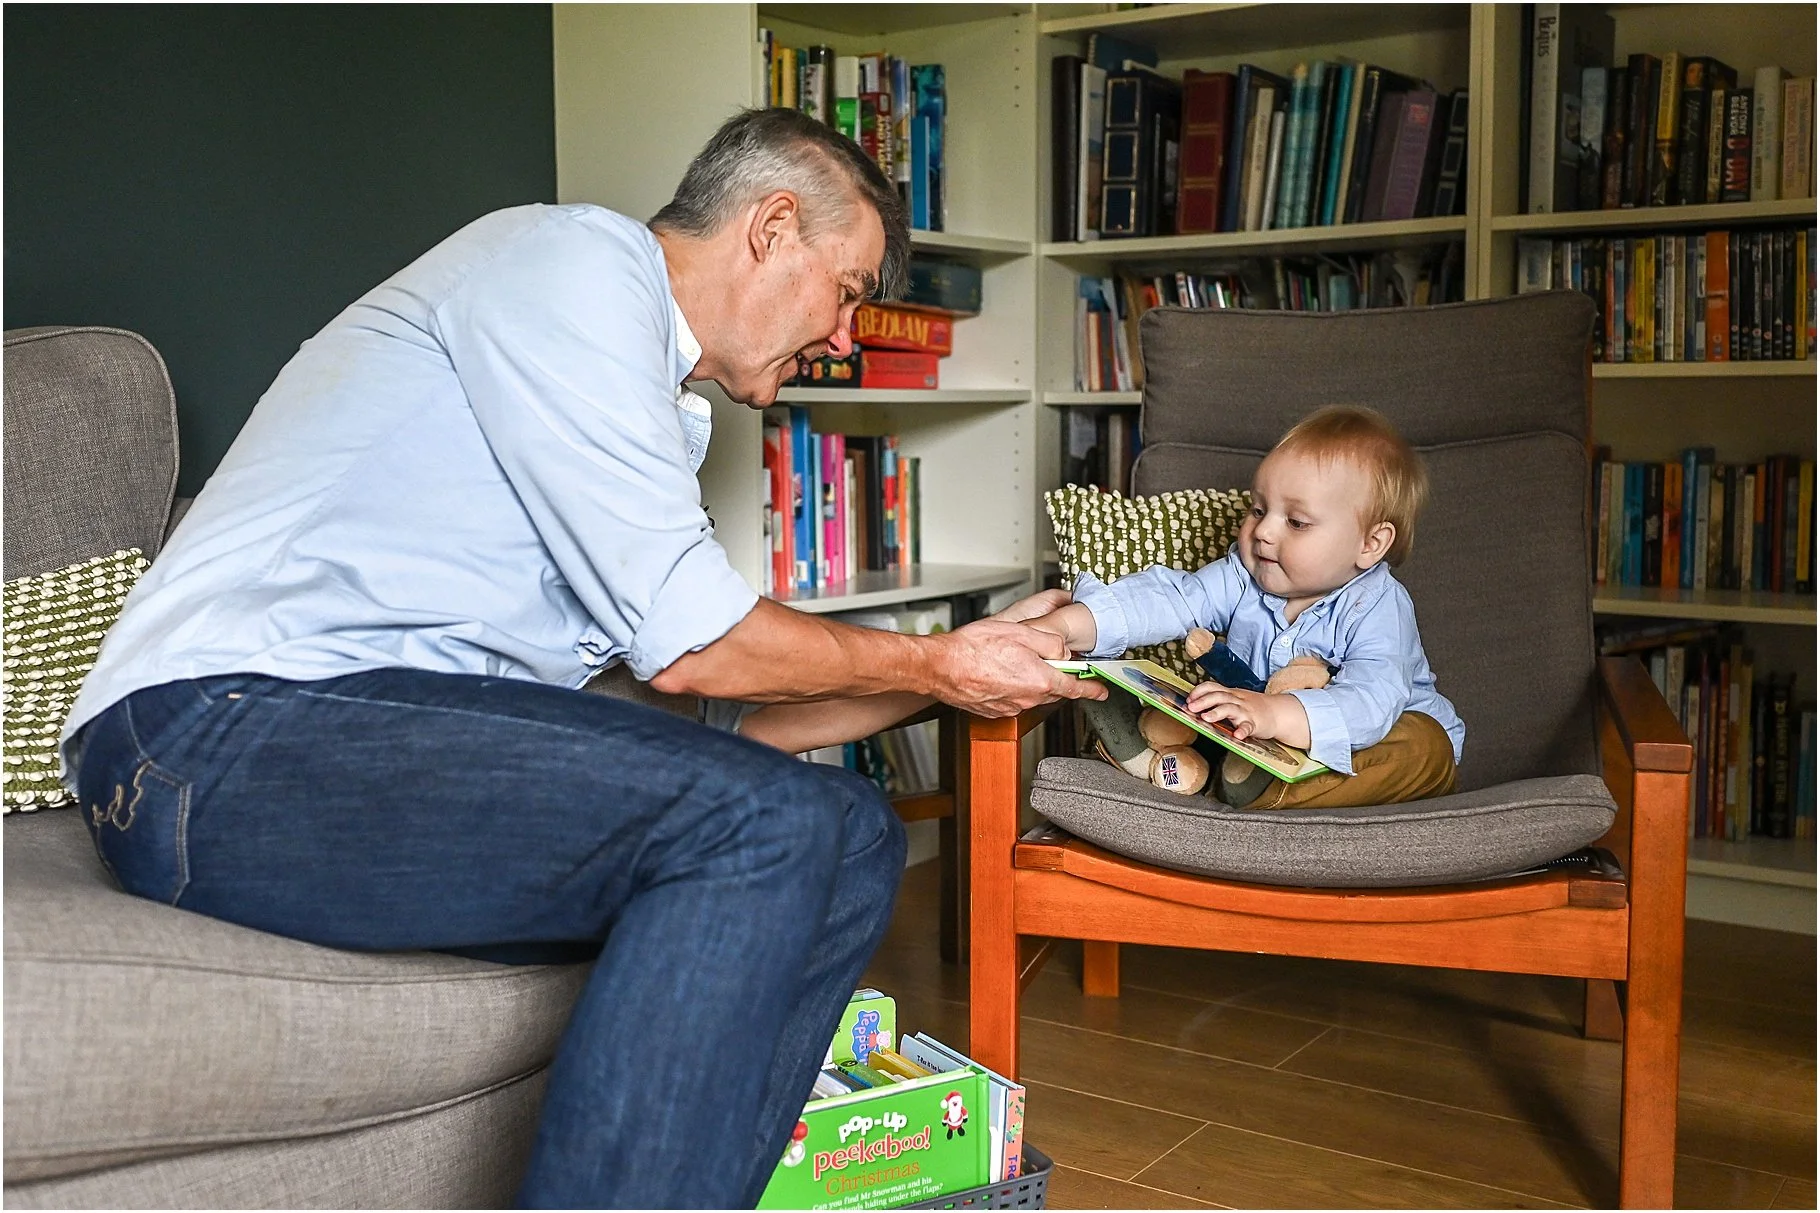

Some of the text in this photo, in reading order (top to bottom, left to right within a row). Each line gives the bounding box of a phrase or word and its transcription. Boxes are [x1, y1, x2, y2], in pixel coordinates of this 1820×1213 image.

[857, 304, 929, 347] BEDLAM
[854, 1012, 878, 1053] Peppa
[814, 1125, 930, 1181] peekaboo!
[826, 1161, 920, 1196] Christmas
[829, 1200, 843, 1210] you
[844, 1193, 860, 1205] find
[860, 1191, 871, 1201] Mr
[872, 1184, 906, 1197] Snowman
[907, 1178, 921, 1189] and
[921, 1176, 933, 1186] his
[864, 1198, 888, 1209] hiding
[888, 1192, 909, 1203] under
[910, 1188, 922, 1198] the
[922, 1182, 944, 1195] flaps?
